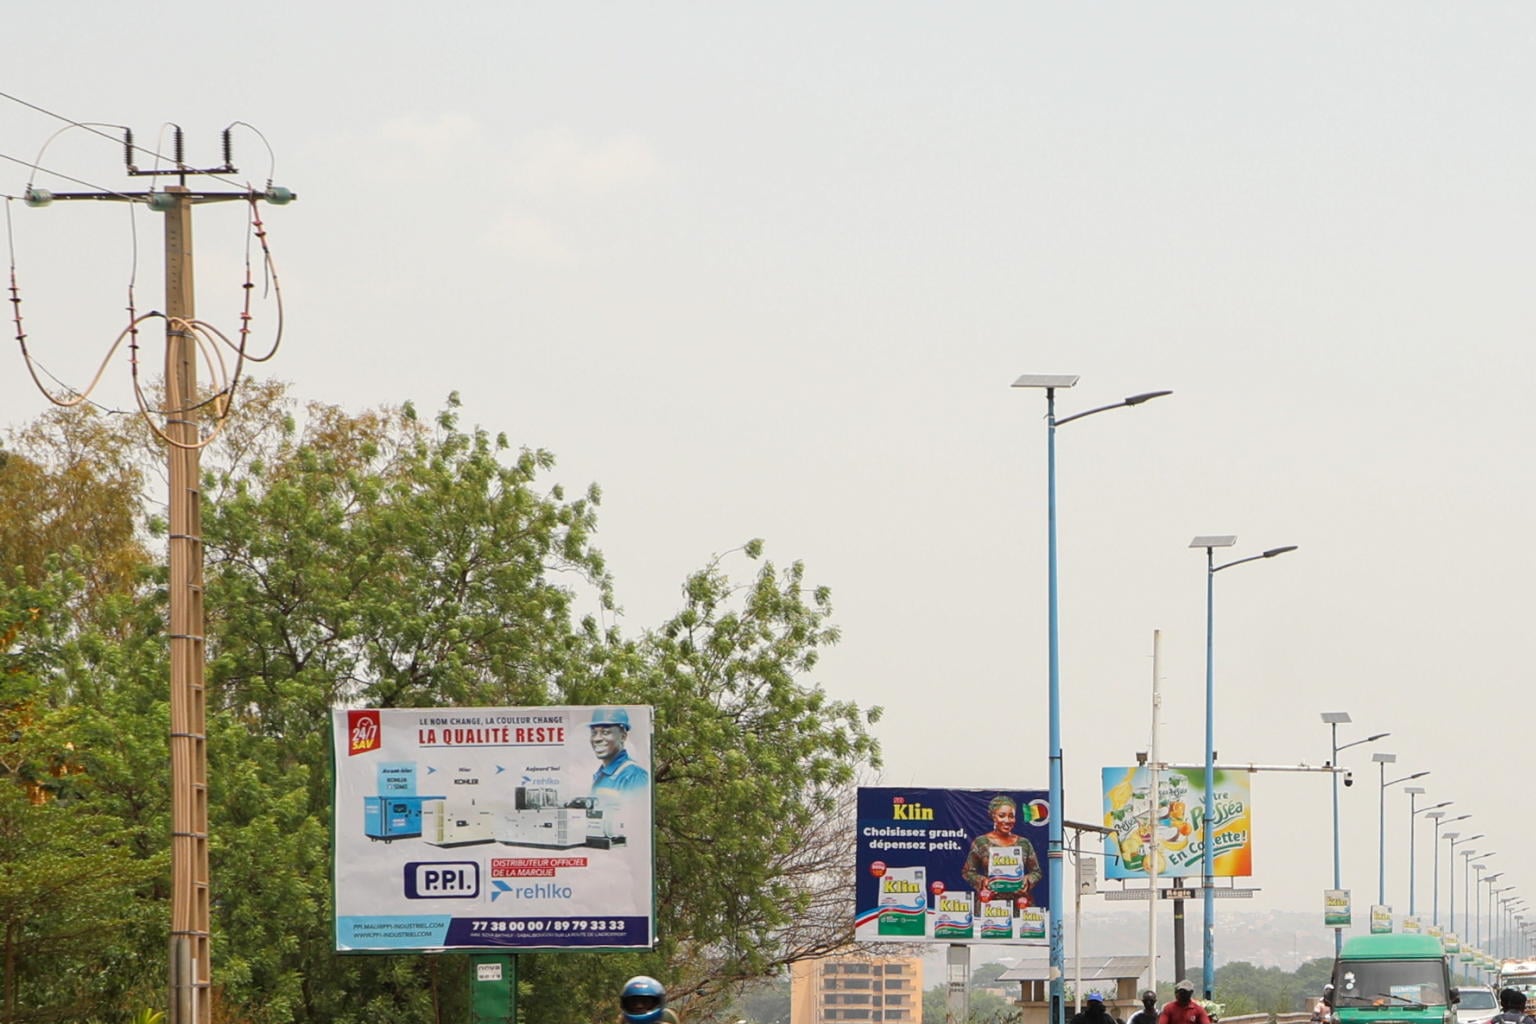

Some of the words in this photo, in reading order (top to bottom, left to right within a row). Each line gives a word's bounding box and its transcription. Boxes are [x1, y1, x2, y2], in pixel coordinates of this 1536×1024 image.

[419, 718, 427, 726] LE
[450, 717, 483, 727] CHANGE,
[485, 717, 494, 725] LA
[496, 716, 530, 725] COULEUR
[532, 716, 563, 724] CHANGE
[352, 725, 378, 741] 24/7
[418, 729, 436, 744] LA
[443, 726, 509, 746] QUALITÉ
[516, 727, 565, 743] RESTE
[352, 739, 374, 750] SAV
[893, 803, 934, 820] Klin
[863, 827, 926, 837] Choisissez
[929, 828, 967, 839] grand,
[869, 839, 926, 851] dépensez
[929, 840, 961, 852] petit.
[492, 858, 549, 868] DISTRIBUTEUR
[551, 858, 586, 867] OFFICIEL
[1168, 850, 1187, 865] En
[492, 869, 504, 877] DE
[505, 868, 517, 877] LA
[518, 868, 554, 877] MARQUE
[515, 883, 572, 899] rehlko
[883, 880, 920, 893] Klin
[940, 899, 969, 912] Klin
[472, 921, 488, 931] 77
[490, 921, 506, 931] 38
[509, 921, 525, 931] 00
[527, 921, 544, 931] 00
[554, 921, 570, 931] 89
[572, 920, 588, 930] 79
[590, 920, 606, 930] 33
[609, 920, 625, 930] 33
